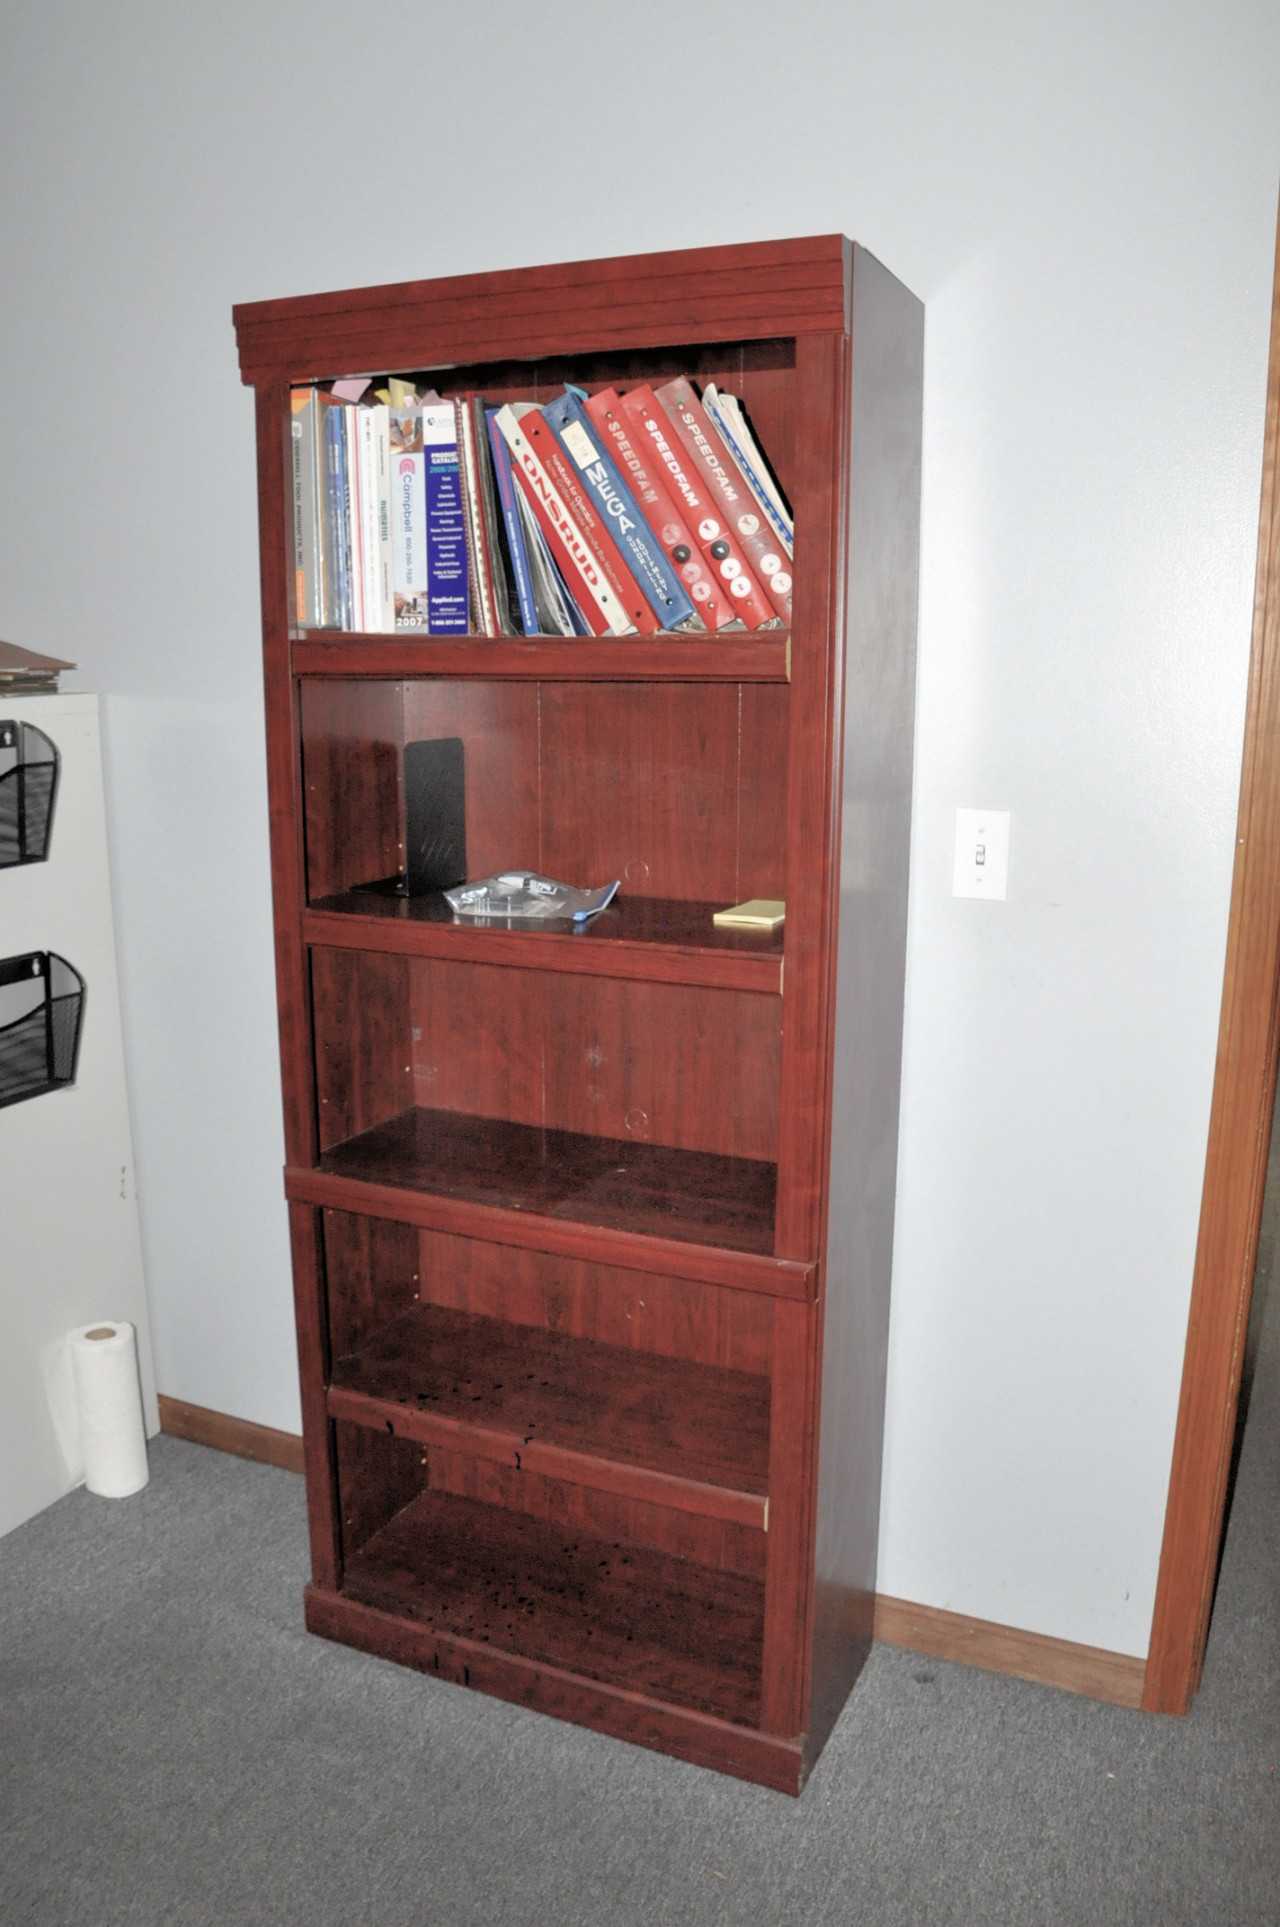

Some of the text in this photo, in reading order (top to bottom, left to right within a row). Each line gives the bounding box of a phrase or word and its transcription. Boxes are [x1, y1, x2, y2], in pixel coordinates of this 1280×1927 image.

[585, 459, 635, 536] MEGA
[609, 421, 659, 503] SPEEDFAM
[644, 418, 699, 508] SPEEDFAM
[682, 412, 739, 502] SPEEDFAM
[402, 474, 413, 533] Campbell
[522, 454, 600, 587] ONSRUD
[396, 617, 423, 627] 2007
